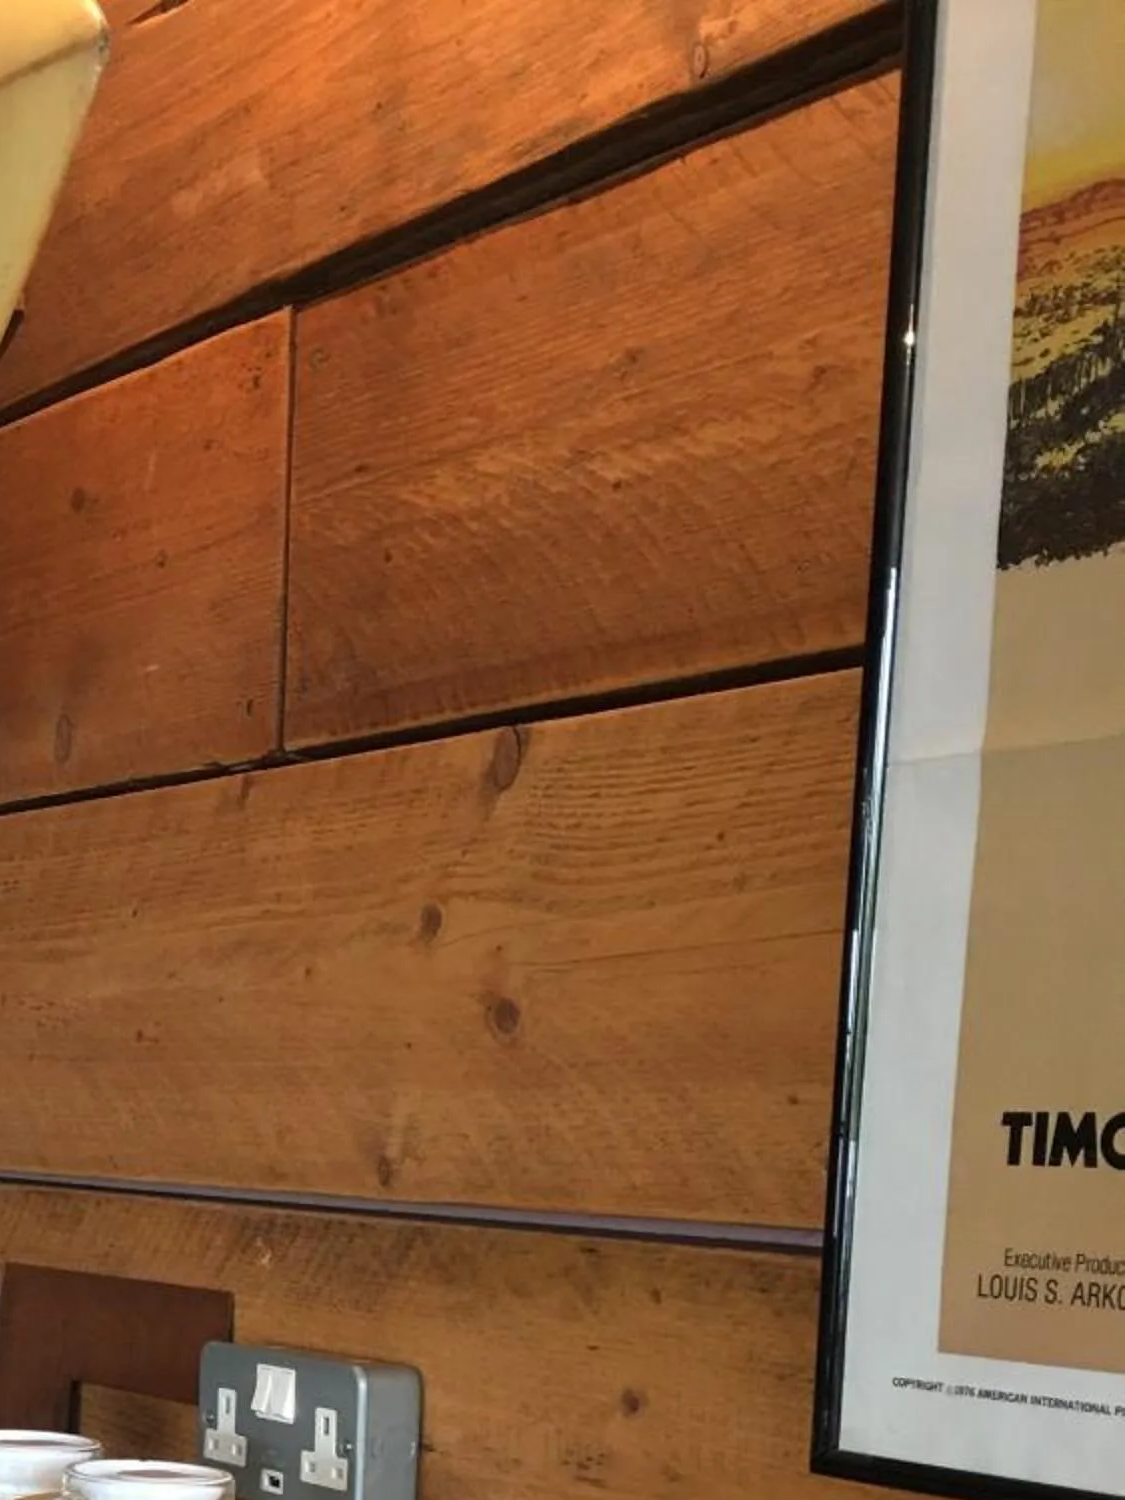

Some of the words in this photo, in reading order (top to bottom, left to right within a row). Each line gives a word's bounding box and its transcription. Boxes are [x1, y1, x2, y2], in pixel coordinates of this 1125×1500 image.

[1004, 1248, 1072, 1272] Executive
[977, 1272, 1038, 1302] LOUIS
[1044, 1278, 1063, 1304] S.
[892, 1377, 944, 1393] COPYRIGHT
[977, 1388, 1027, 1405] AMERICAN
[1030, 1394, 1111, 1416] INTERNATIONAL
